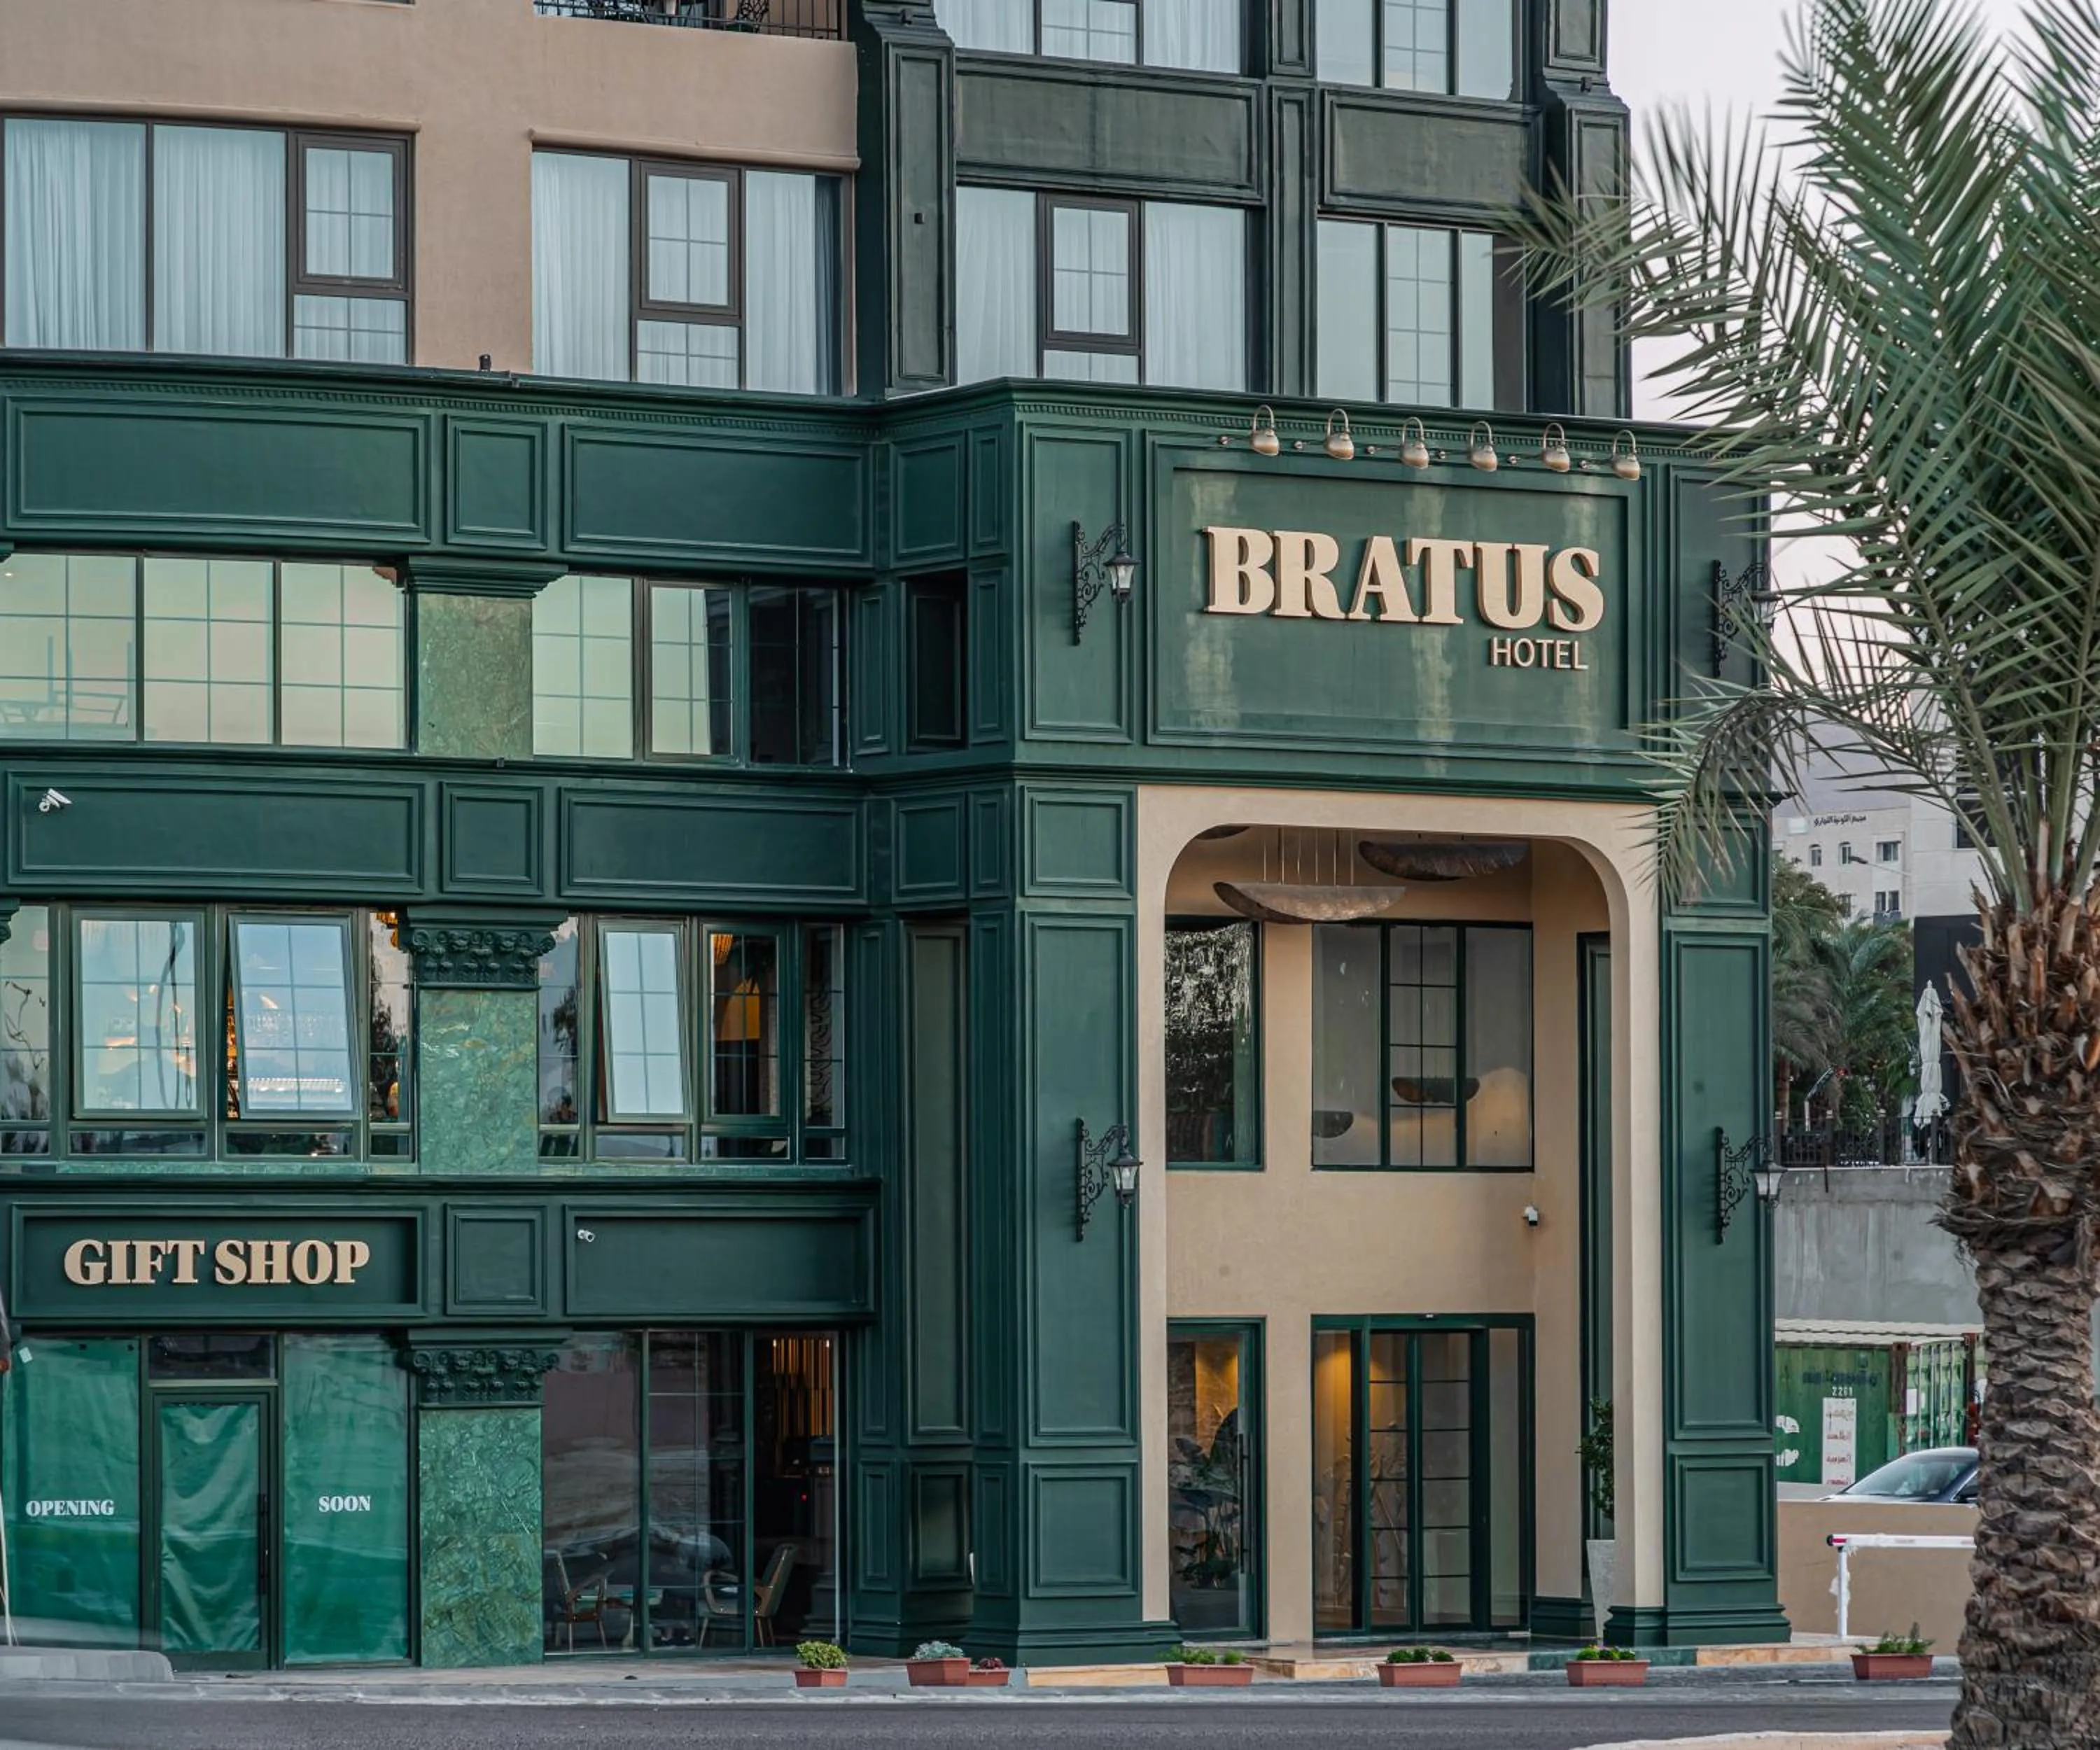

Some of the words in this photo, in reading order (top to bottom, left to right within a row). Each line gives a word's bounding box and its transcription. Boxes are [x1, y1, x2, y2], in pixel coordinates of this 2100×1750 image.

[1202, 526, 1604, 631] BRATUS
[1490, 637, 1588, 669] HOTEL
[64, 1239, 205, 1285] GIFT
[214, 1239, 370, 1285] SHOP
[26, 1499, 114, 1516] OPENING
[318, 1495, 371, 1512] SOON
